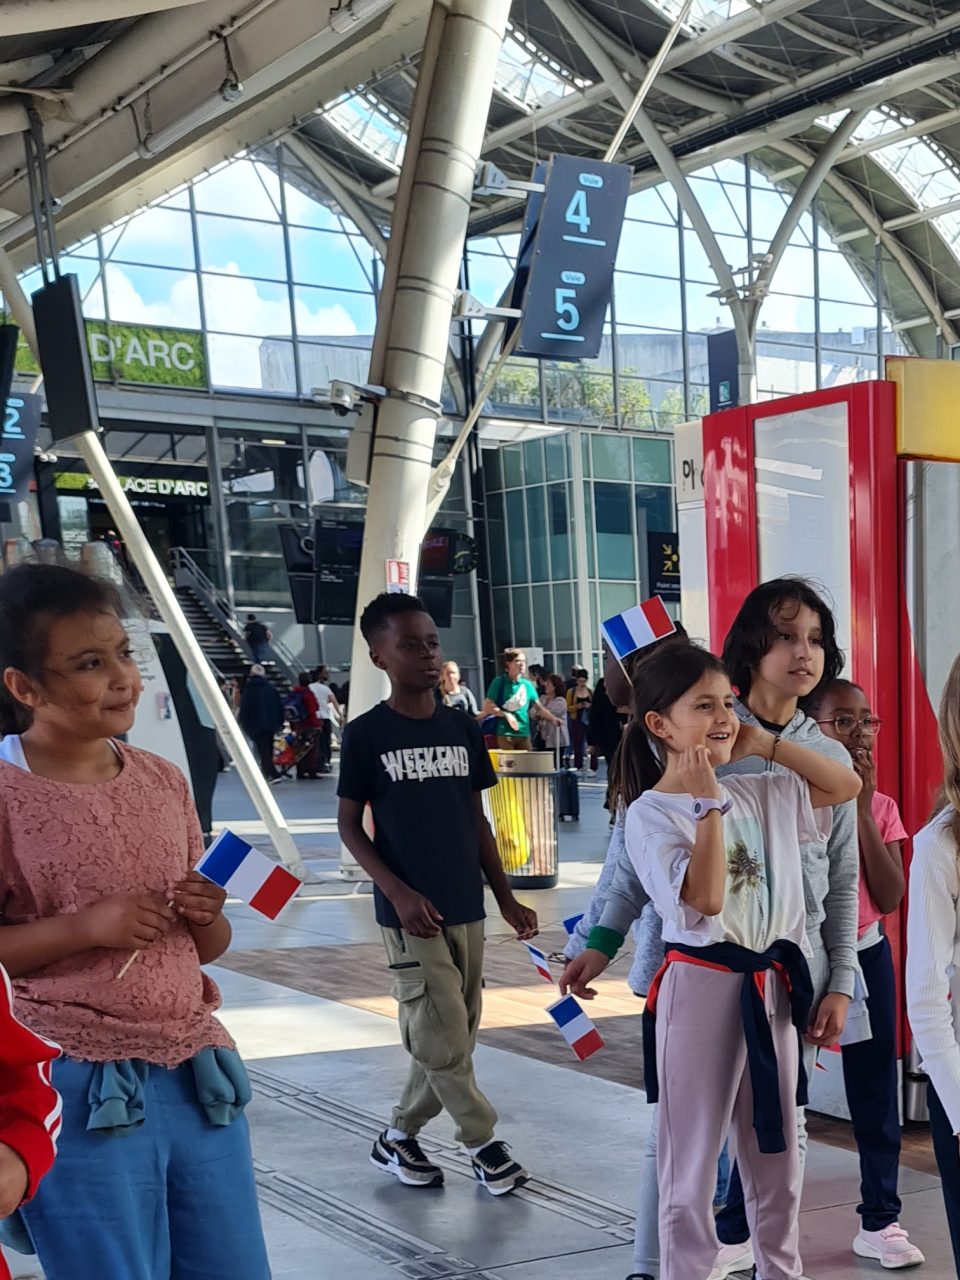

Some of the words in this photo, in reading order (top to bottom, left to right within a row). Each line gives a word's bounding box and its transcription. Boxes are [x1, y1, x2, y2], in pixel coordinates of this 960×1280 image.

[565, 189, 591, 234] 4
[554, 288, 580, 331] 5
[88, 332, 196, 372] D'ARC
[3, 407, 22, 433] 2
[158, 480, 209, 497] D'ARC
[380, 745, 470, 783] WEEKEND
